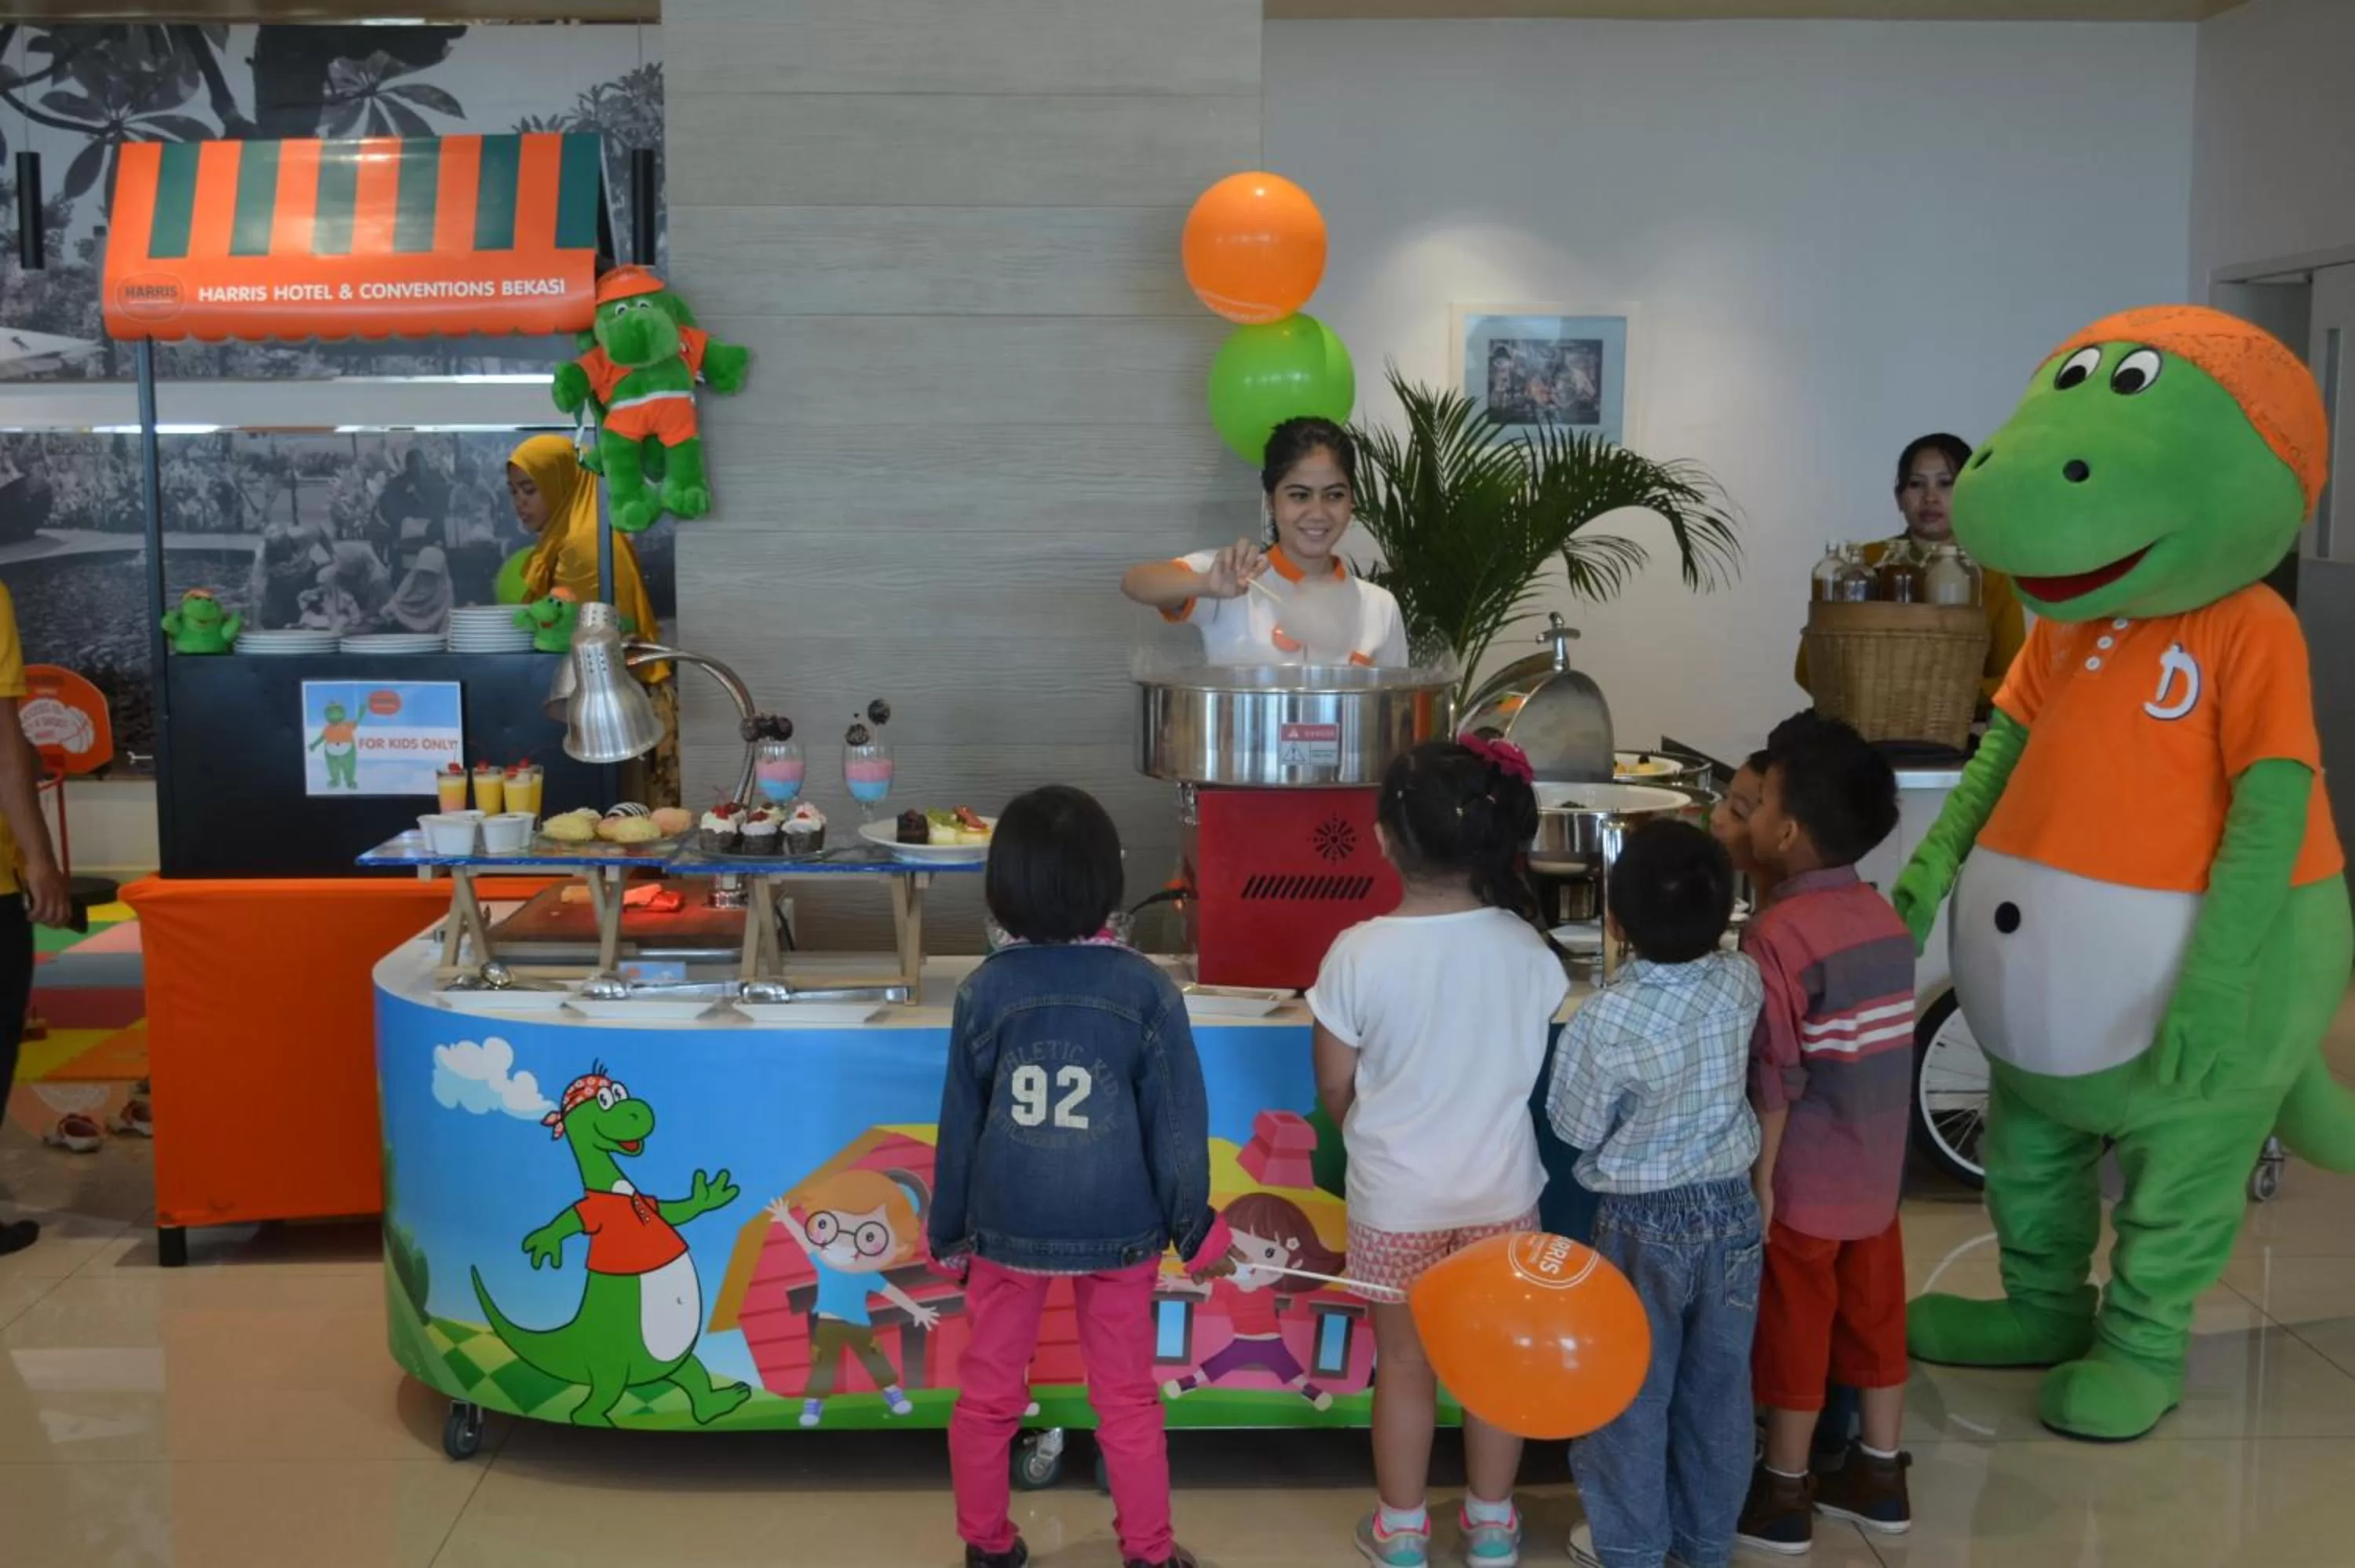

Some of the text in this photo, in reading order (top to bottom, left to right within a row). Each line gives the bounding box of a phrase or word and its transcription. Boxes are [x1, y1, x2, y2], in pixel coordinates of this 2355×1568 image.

[124, 284, 178, 298] HARRIS
[198, 279, 566, 302] HARRIS HOTEL & CONVENTIONS BEKASI
[358, 737, 385, 750] FOR
[388, 737, 418, 751] KIDS
[1010, 1065, 1092, 1129] 92
[1539, 1234, 1573, 1274] ARRIS
